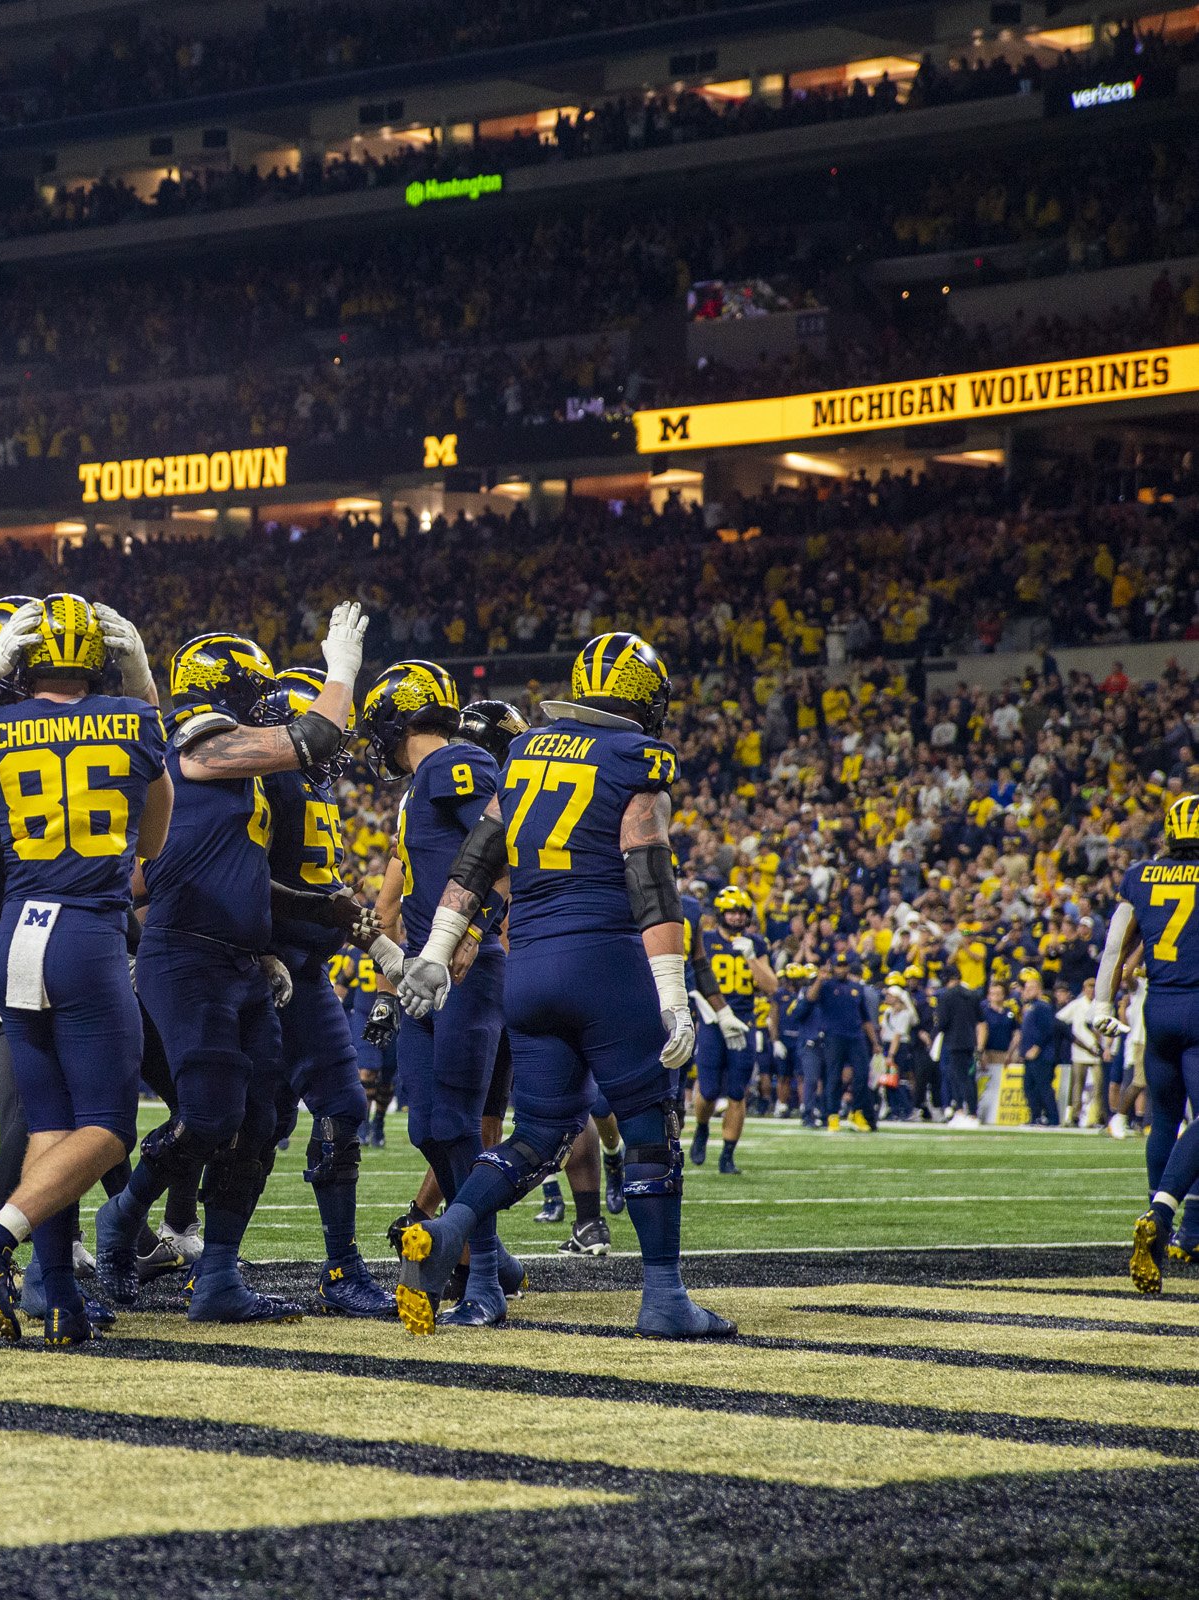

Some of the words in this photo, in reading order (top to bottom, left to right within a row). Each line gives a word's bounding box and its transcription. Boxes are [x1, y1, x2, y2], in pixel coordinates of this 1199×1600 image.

[1071, 81, 1136, 109] verizon
[425, 174, 502, 200] Huntington
[659, 415, 689, 442] M
[812, 383, 958, 429] MICHIGAN
[972, 355, 1170, 408] WOLVERINES
[423, 433, 458, 468] M
[78, 445, 288, 502] TOUCHDOWN
[523, 733, 597, 760] KEEGAN
[452, 763, 474, 796] 9
[643, 748, 676, 784] 77
[504, 759, 599, 870] 77
[24, 908, 52, 928] M
[1149, 884, 1197, 963] 7
[328, 1267, 344, 1281] M
